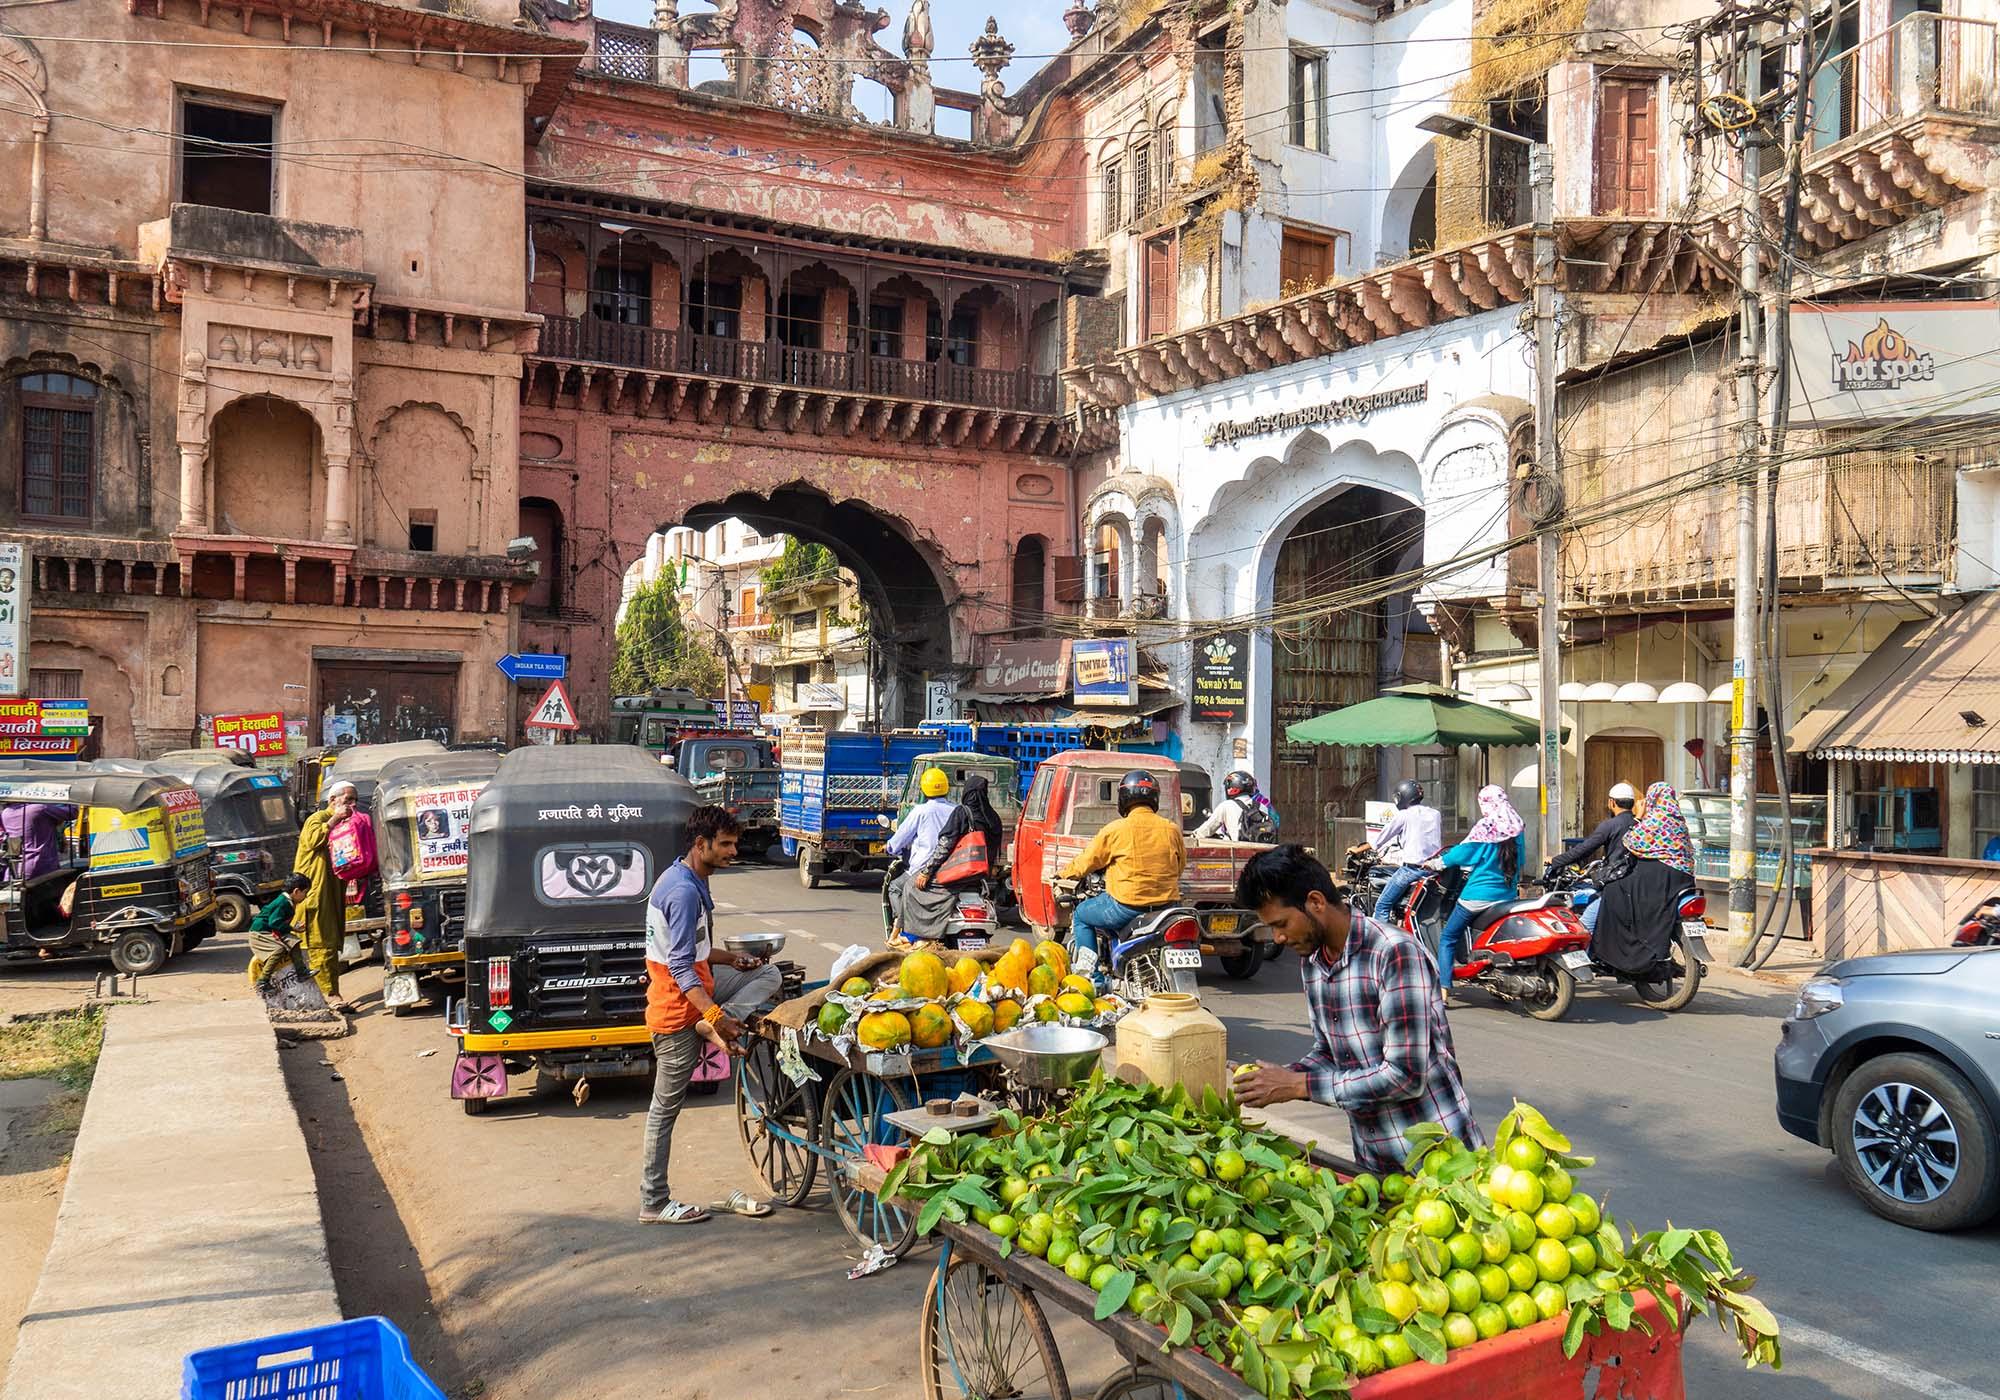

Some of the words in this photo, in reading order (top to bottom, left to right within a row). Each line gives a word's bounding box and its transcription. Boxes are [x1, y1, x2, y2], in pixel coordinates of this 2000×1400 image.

[1832, 353, 1878, 383] hot
[1879, 353, 1934, 389] spot
[1298, 402, 1328, 426] BBQ
[1339, 383, 1425, 421] Restaurant
[1004, 656, 1031, 687] Chai
[1196, 677, 1228, 690] Nawab's
[1228, 677, 1243, 690] Inn
[1215, 695, 1245, 705] Restaurant
[457, 790, 469, 802] का
[538, 805, 583, 820] प्रजापति
[586, 803, 603, 818] की
[608, 803, 643, 823] गुड़िया
[493, 1017, 507, 1025] LPG
